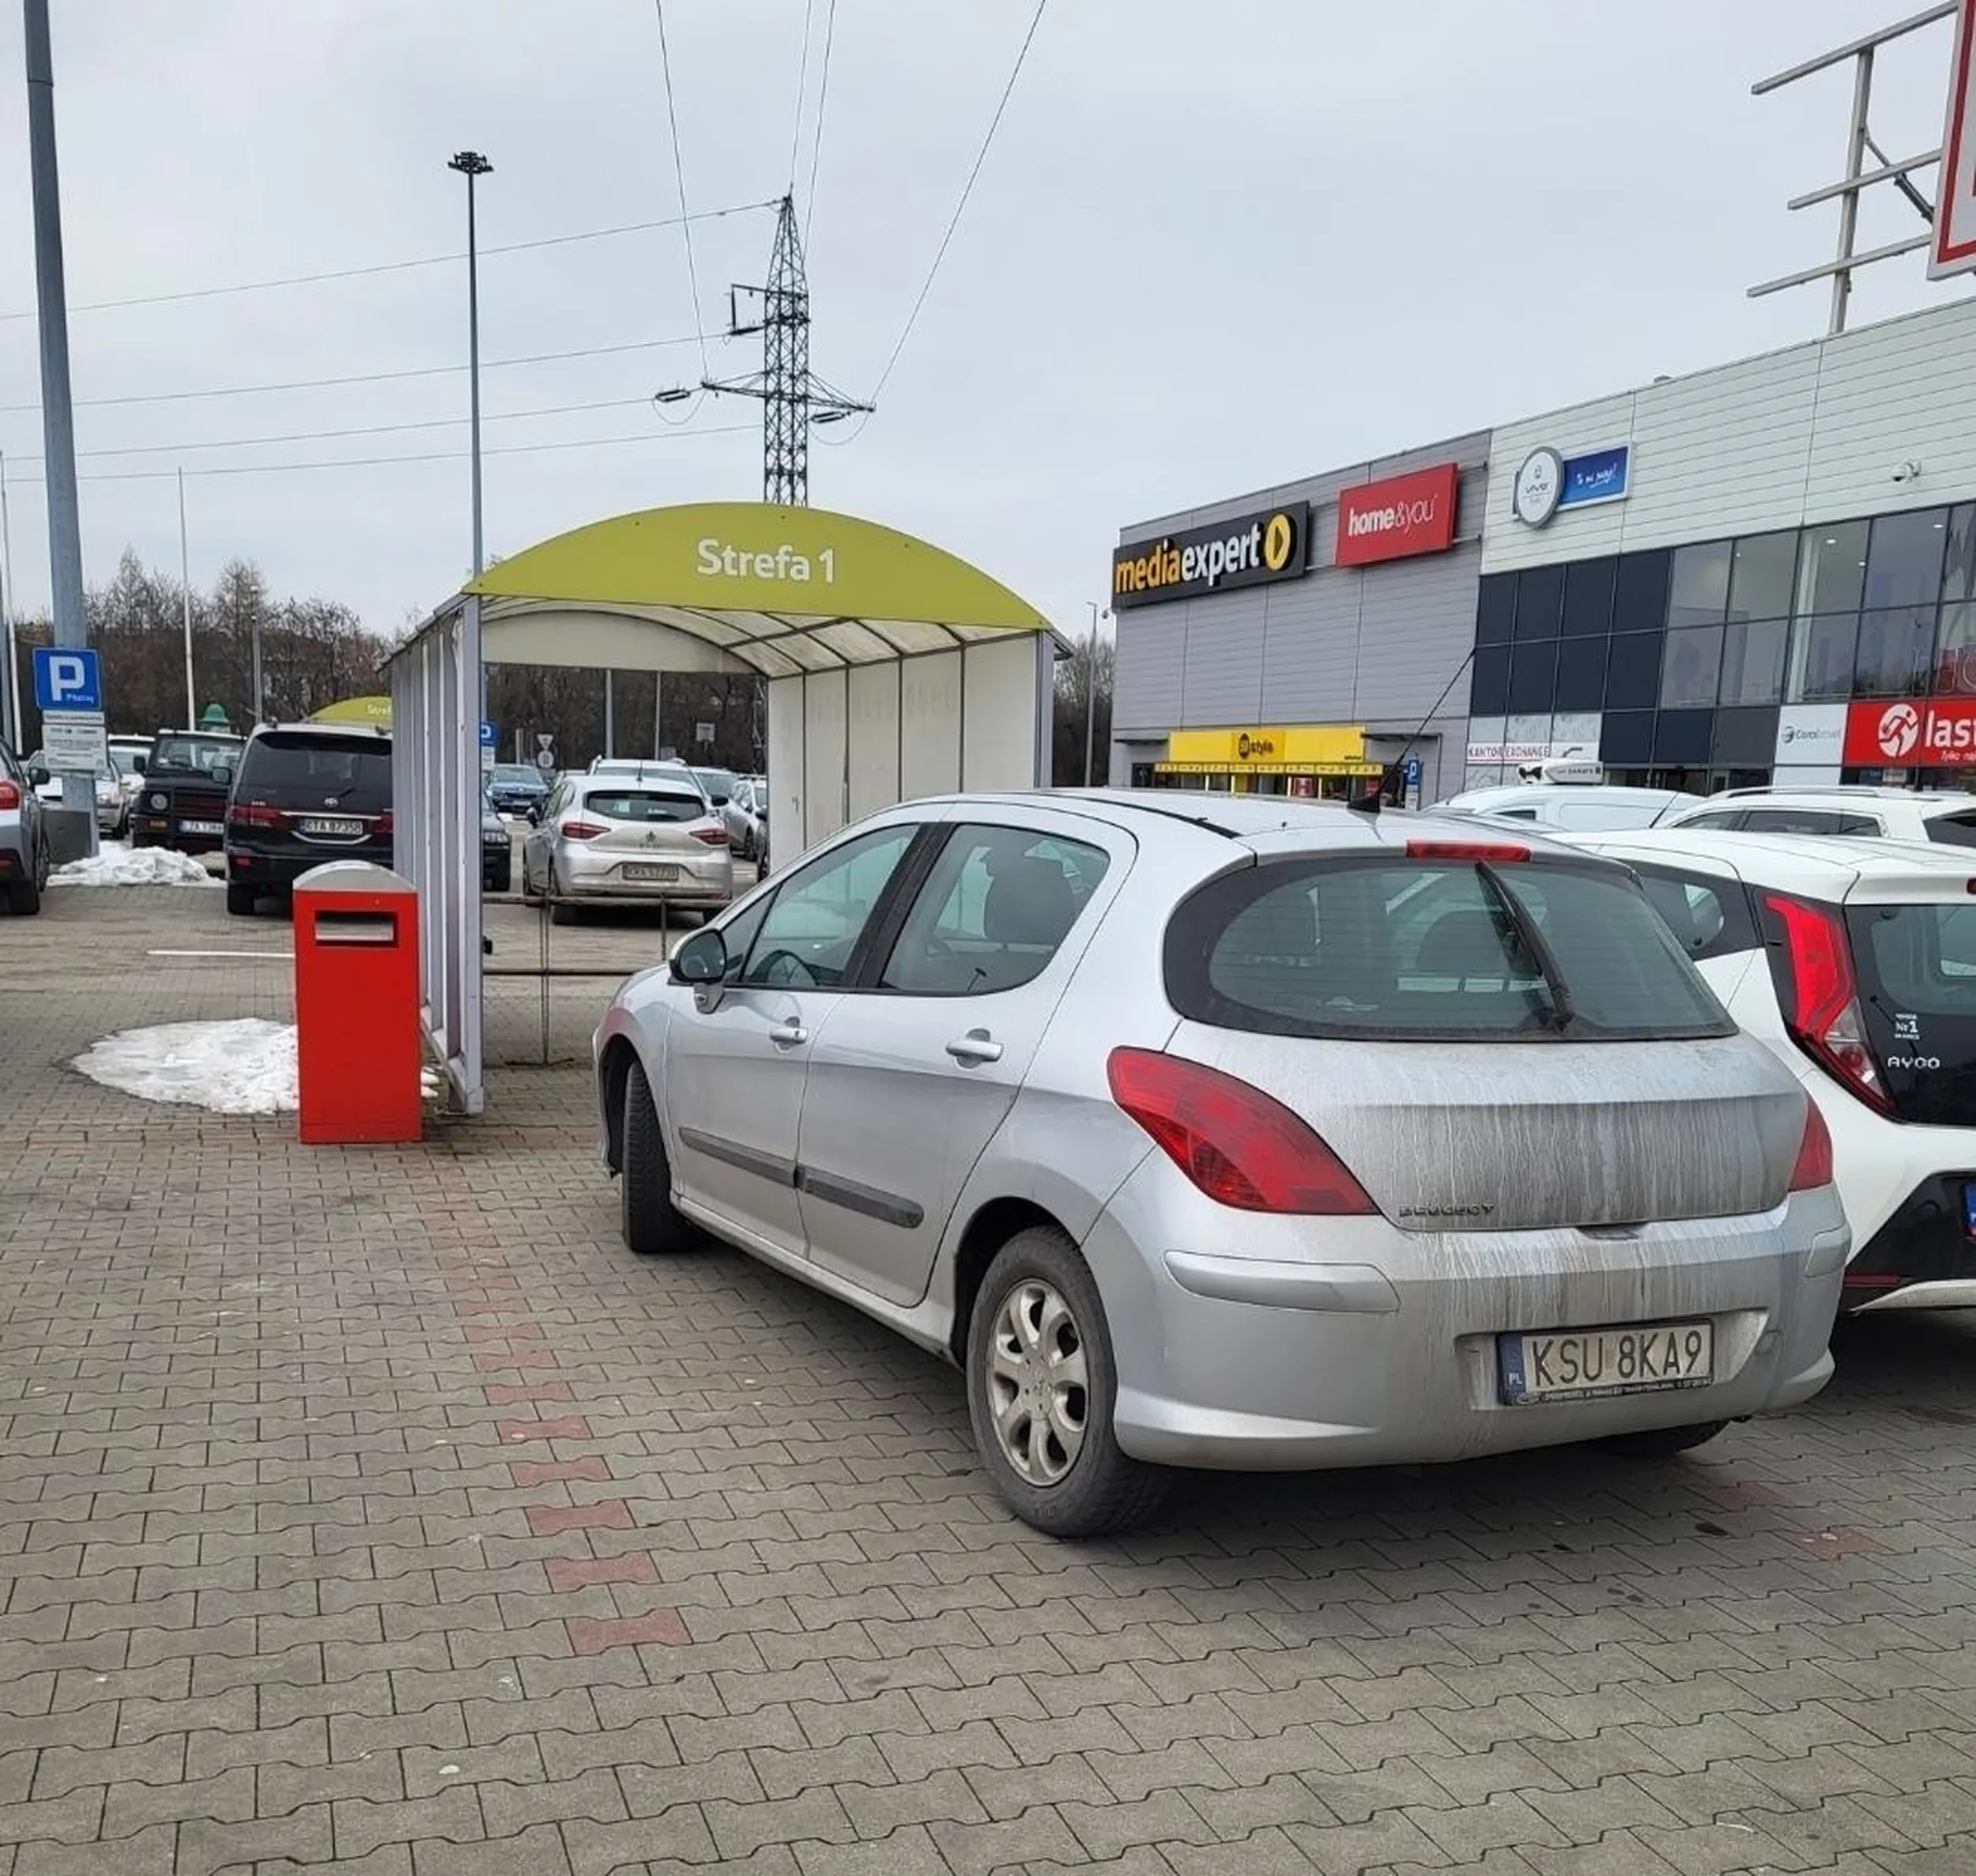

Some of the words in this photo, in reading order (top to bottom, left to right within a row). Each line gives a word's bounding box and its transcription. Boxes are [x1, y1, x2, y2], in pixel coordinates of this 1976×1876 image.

[1348, 493, 1438, 537] home&you
[697, 538, 810, 582] Strefa
[819, 548, 835, 583] 1
[1116, 523, 1261, 593] mediaexpert
[49, 656, 85, 702] P
[1887, 1056, 1940, 1069] AYGO
[1399, 1202, 1494, 1217] PEUGEOT
[1509, 1372, 1522, 1384] PL
[1532, 1337, 1603, 1387] KSU
[1618, 1331, 1702, 1379] 8KA9
